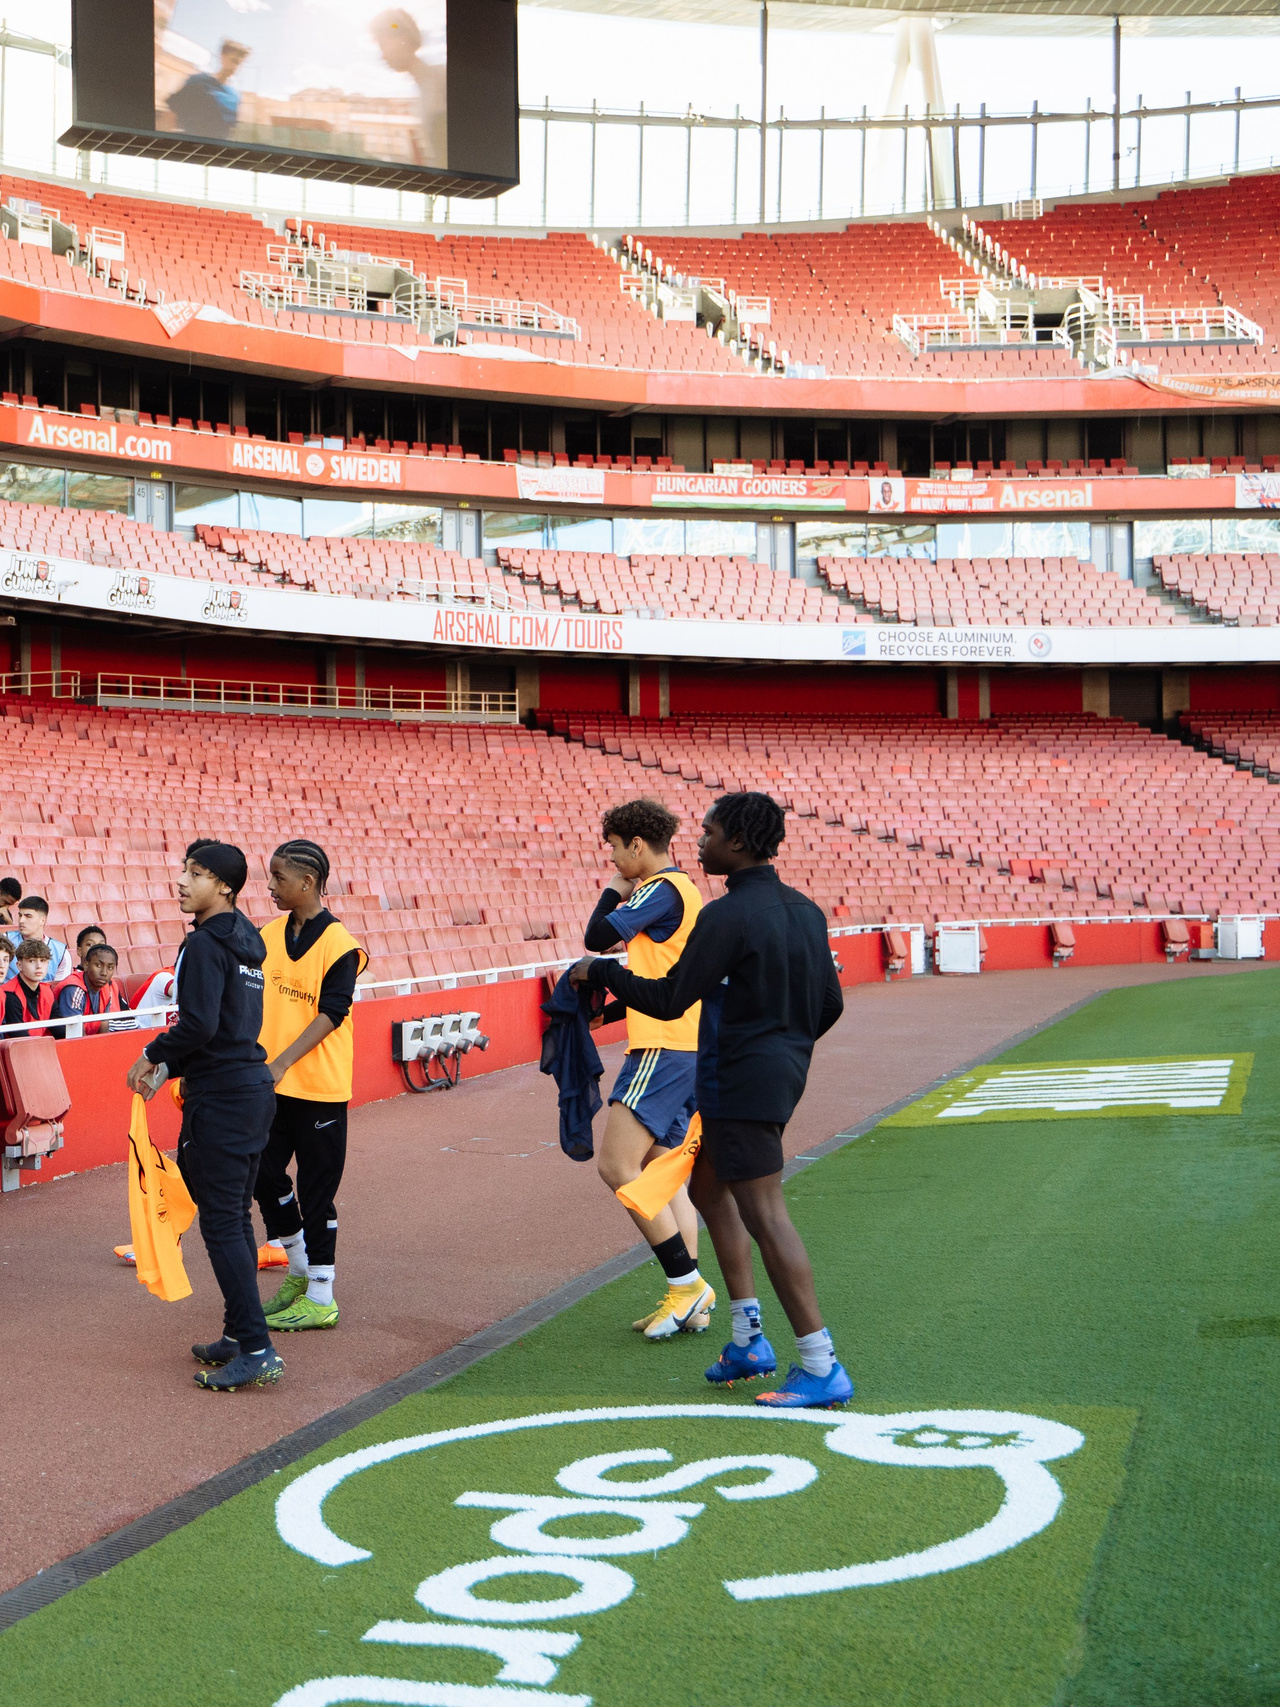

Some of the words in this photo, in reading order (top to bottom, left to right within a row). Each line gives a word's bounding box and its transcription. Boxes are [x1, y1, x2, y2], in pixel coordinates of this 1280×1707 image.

[27, 415, 172, 461] Arsenal.com
[232, 442, 301, 475] ARSENAL
[330, 455, 402, 484] SWEDEN
[539, 469, 604, 491] Arsenal
[656, 475, 738, 495] HUNGARIAN
[741, 477, 807, 496] GOONERS
[136, 487, 146, 498] 45
[999, 482, 1093, 509] Arsenal
[433, 609, 623, 650] ARSENAL.COM/TOURS
[878, 631, 934, 643] CHOOSE
[938, 631, 1018, 644] ALUMINIUM.
[879, 644, 948, 656] RECYCLES
[952, 645, 1016, 658] FOREVER.
